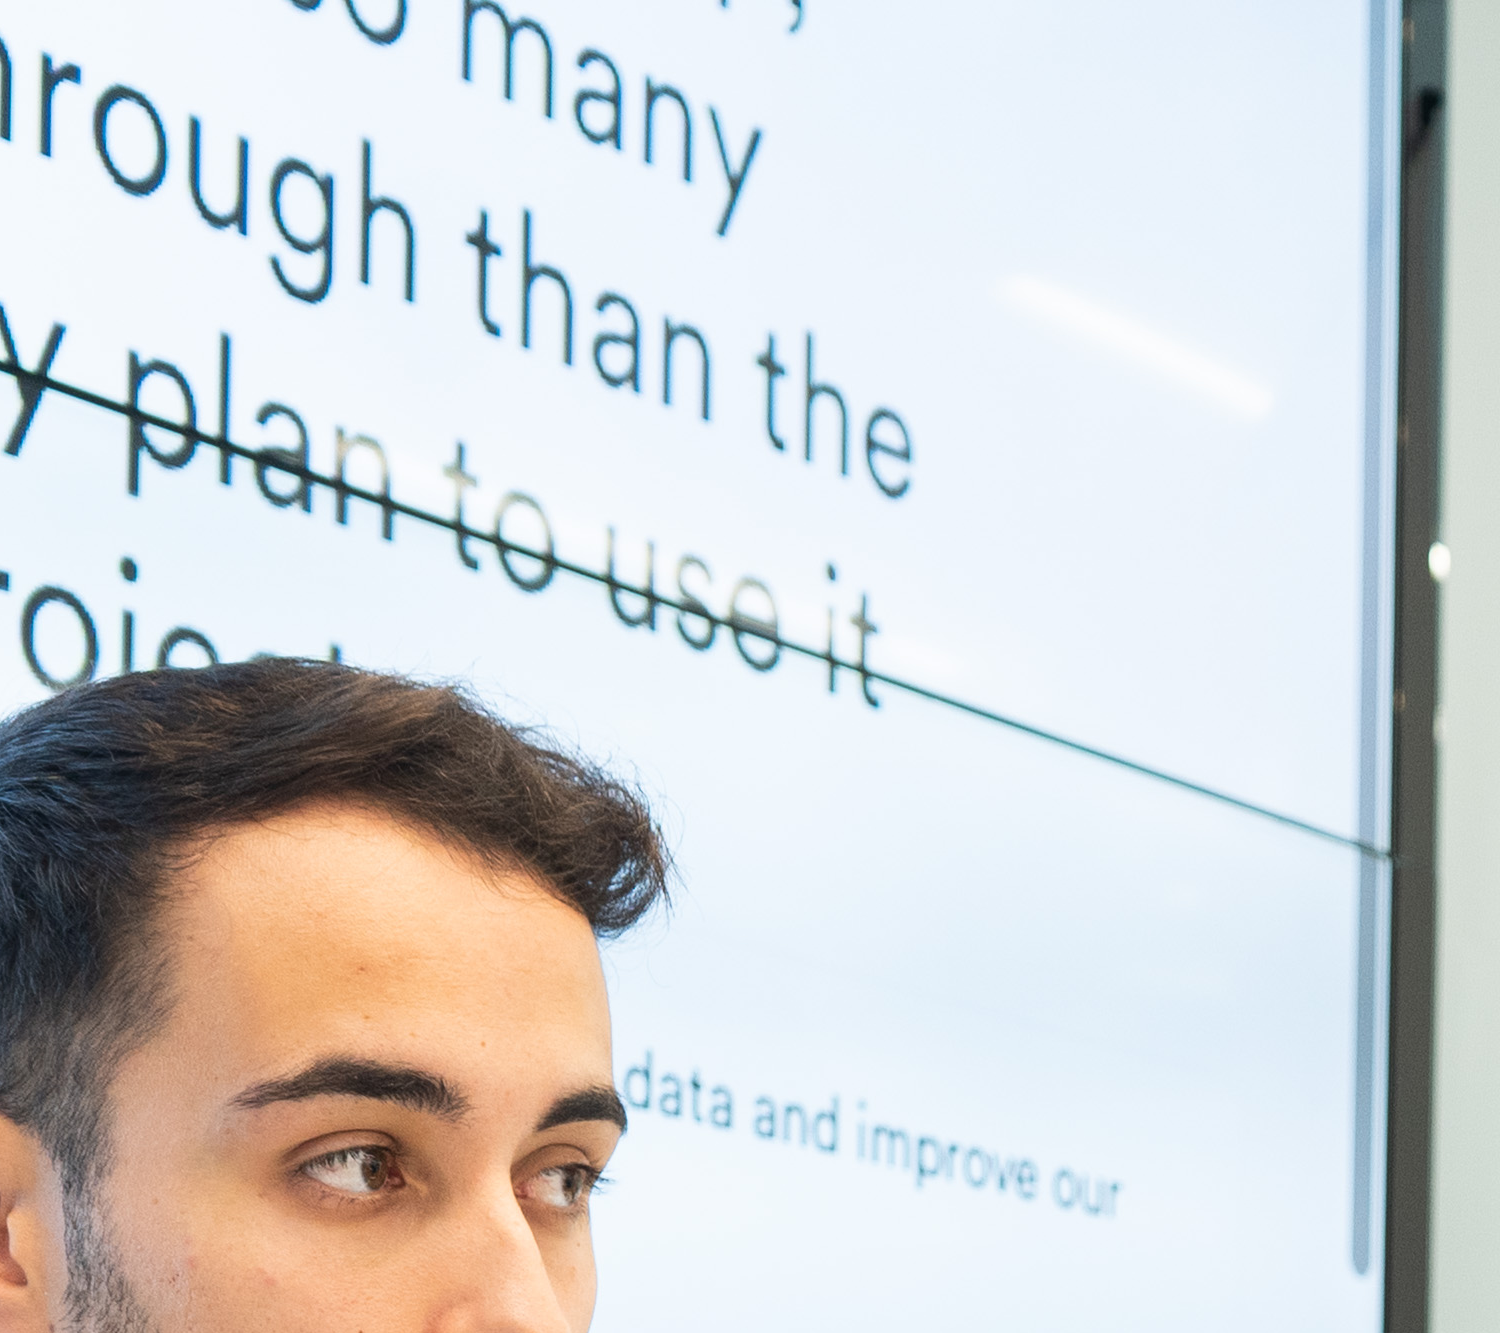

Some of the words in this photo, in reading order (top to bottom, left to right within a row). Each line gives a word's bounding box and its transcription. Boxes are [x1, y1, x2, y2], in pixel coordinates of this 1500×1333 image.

[460, 0, 764, 237] many
[466, 208, 712, 421] than
[756, 331, 913, 499] the
[128, 332, 393, 540] plan
[443, 440, 556, 593] to
[606, 527, 781, 672] use
[826, 562, 880, 708] it
[623, 1048, 732, 1129] data
[753, 1092, 840, 1154] and
[855, 1098, 1040, 1202] improve
[1052, 1166, 1122, 1218] our
